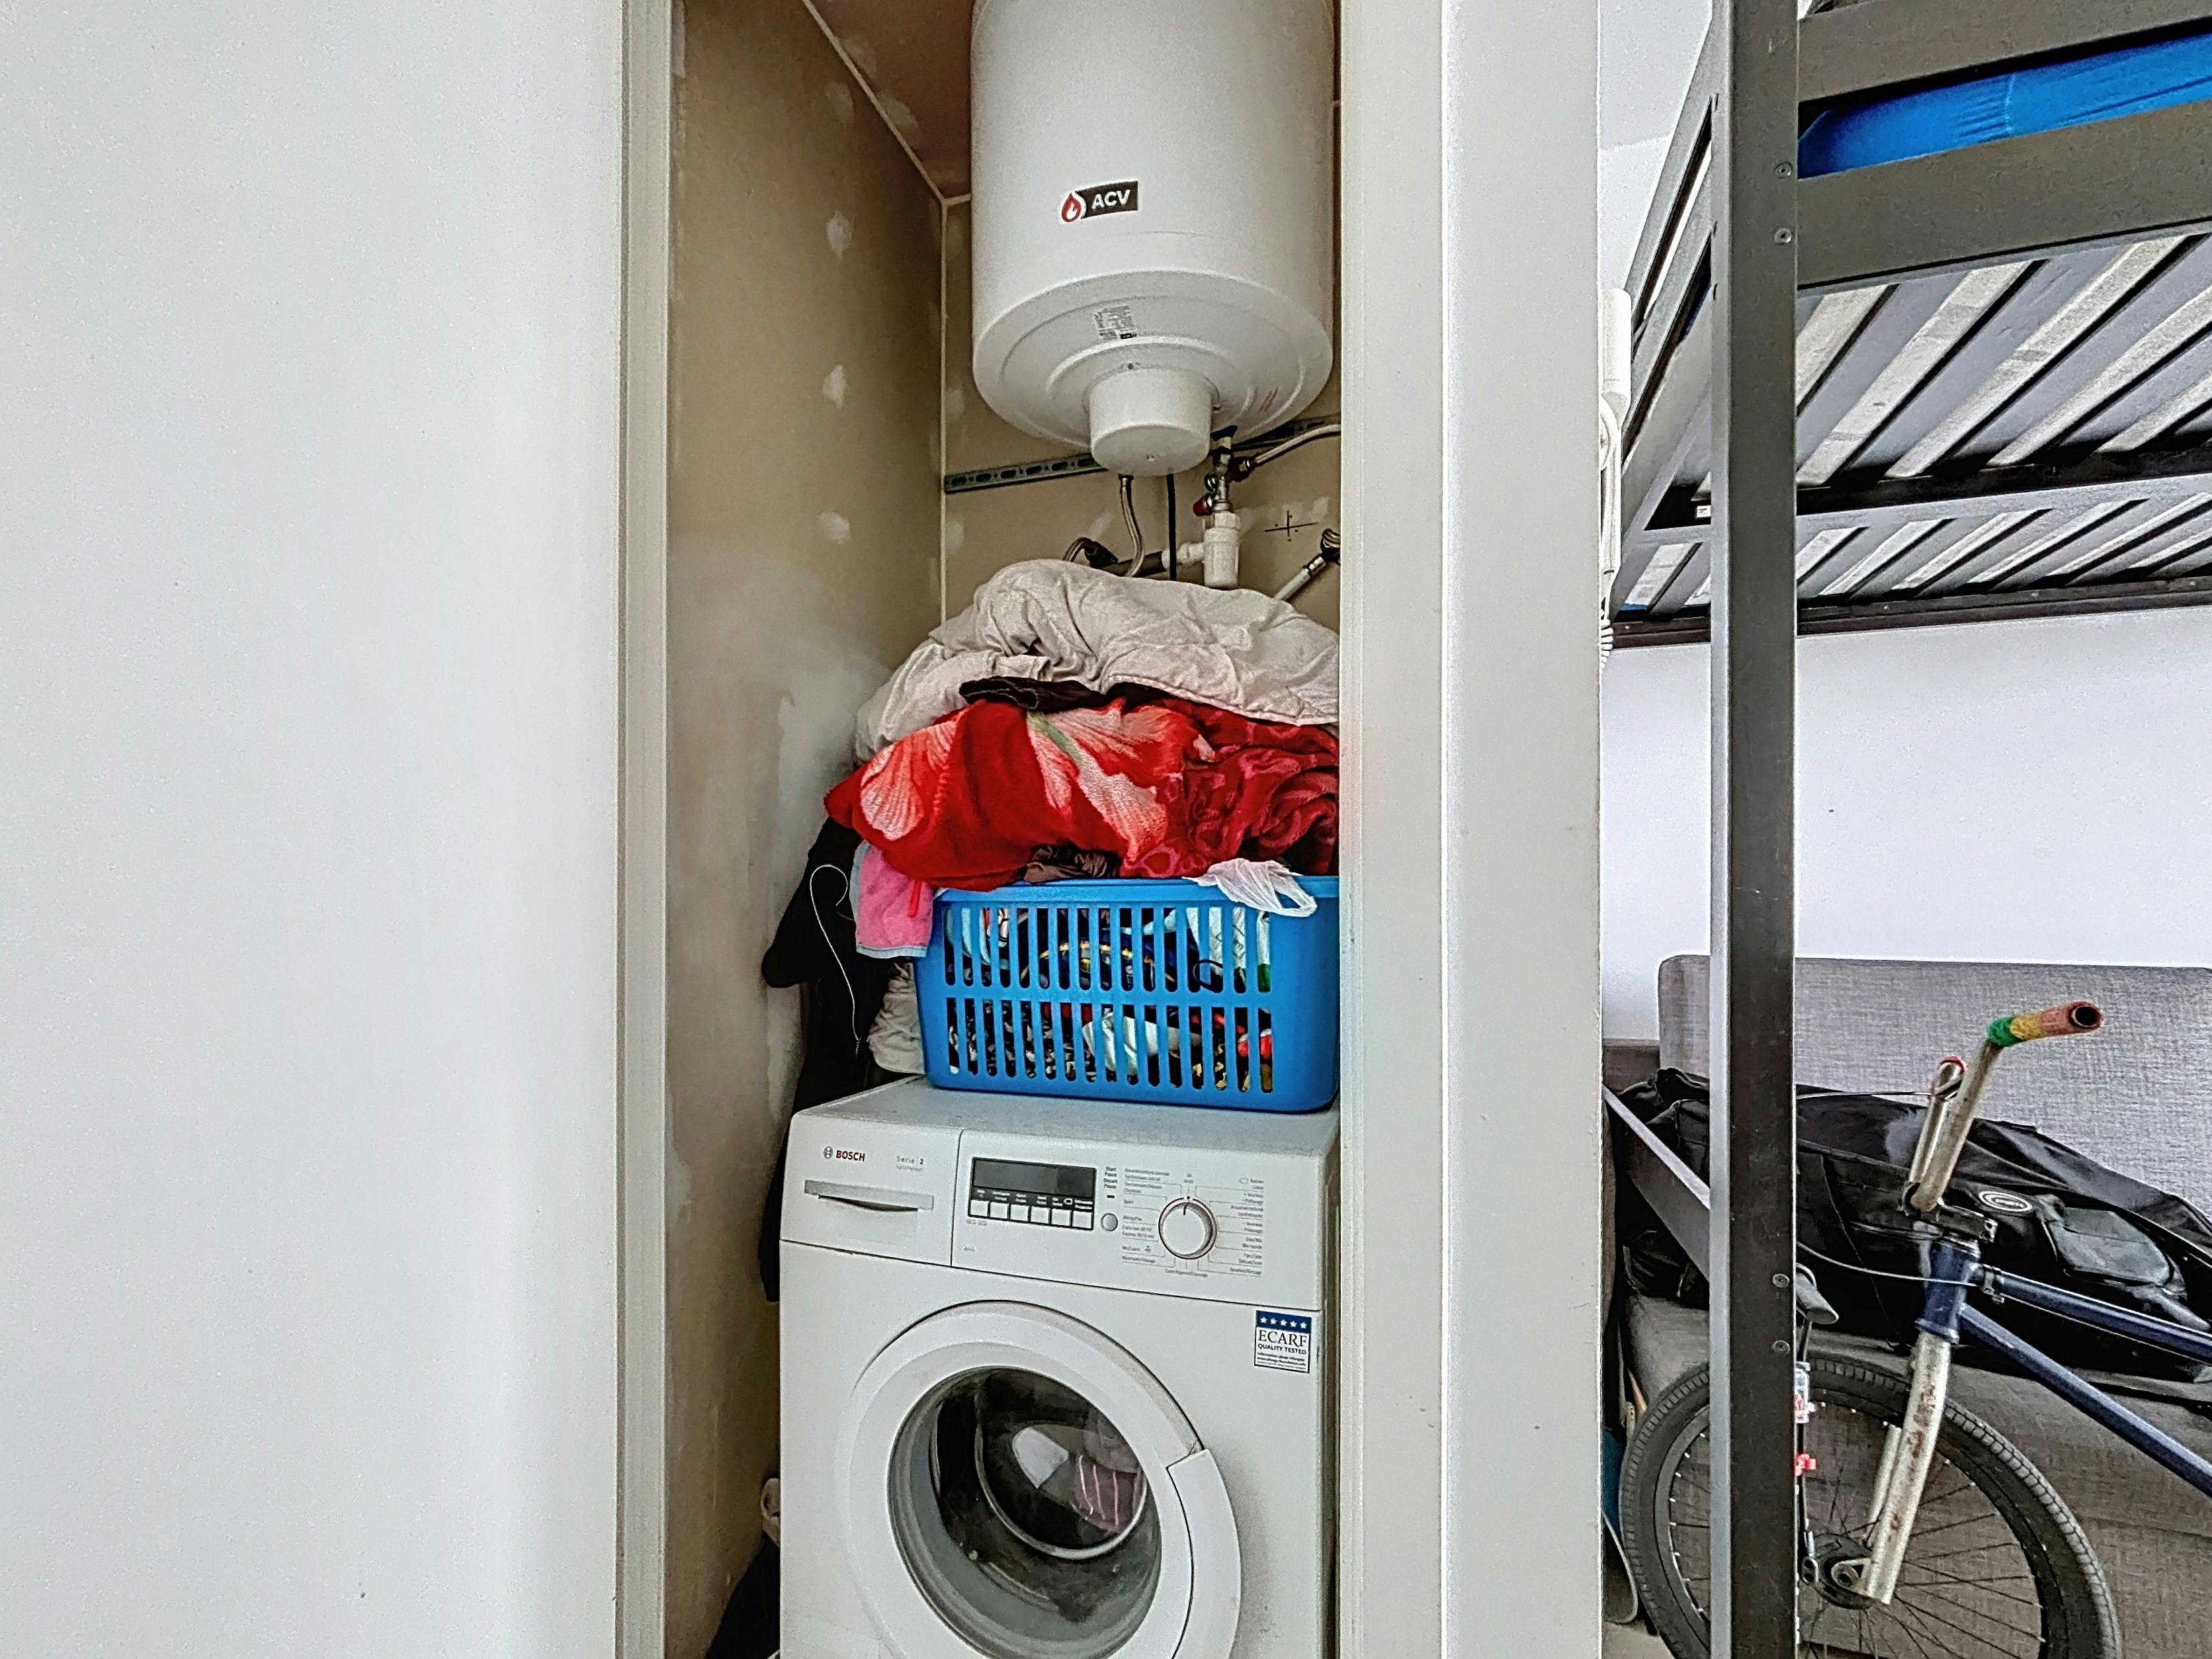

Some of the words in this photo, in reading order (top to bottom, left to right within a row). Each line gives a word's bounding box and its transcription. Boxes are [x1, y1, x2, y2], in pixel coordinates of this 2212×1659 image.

[1091, 189, 1130, 210] ACV
[835, 1150, 866, 1162] BOSCH
[896, 1156, 915, 1165] Serie
[1258, 1330, 1307, 1347] ECARF
